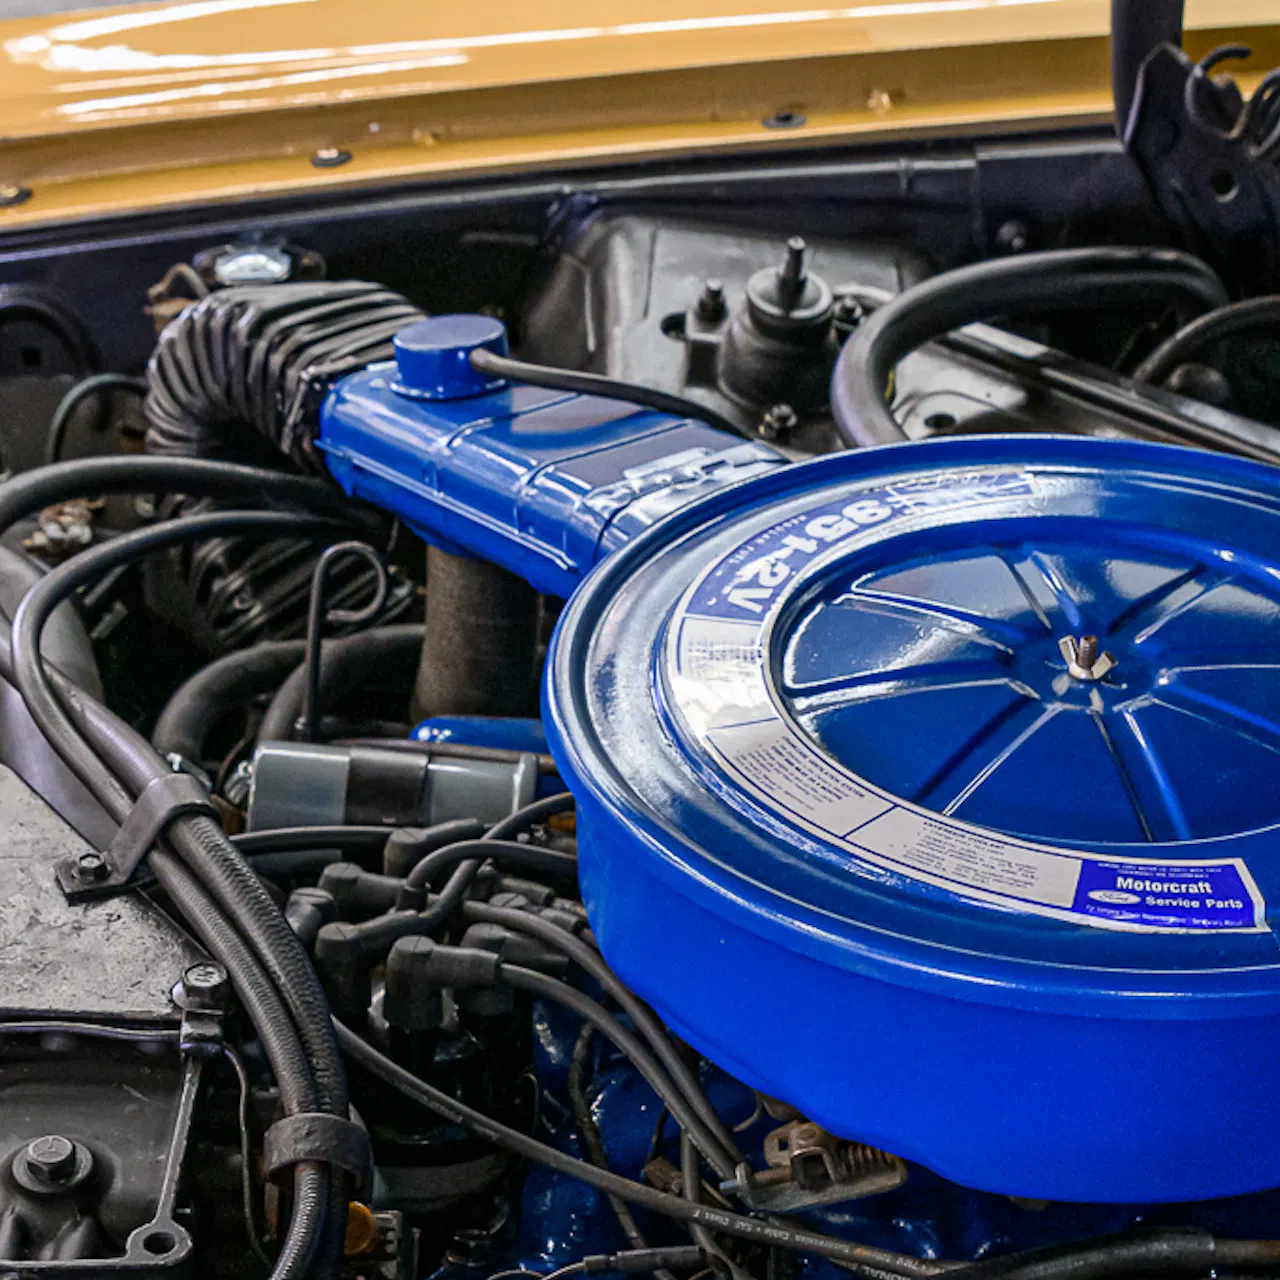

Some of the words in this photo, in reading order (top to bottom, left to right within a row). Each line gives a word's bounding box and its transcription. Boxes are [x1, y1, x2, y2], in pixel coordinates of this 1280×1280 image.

[1116, 876, 1213, 894] Motorcraft
[1144, 896, 1201, 909] Service
[1206, 898, 1245, 910] Parts
